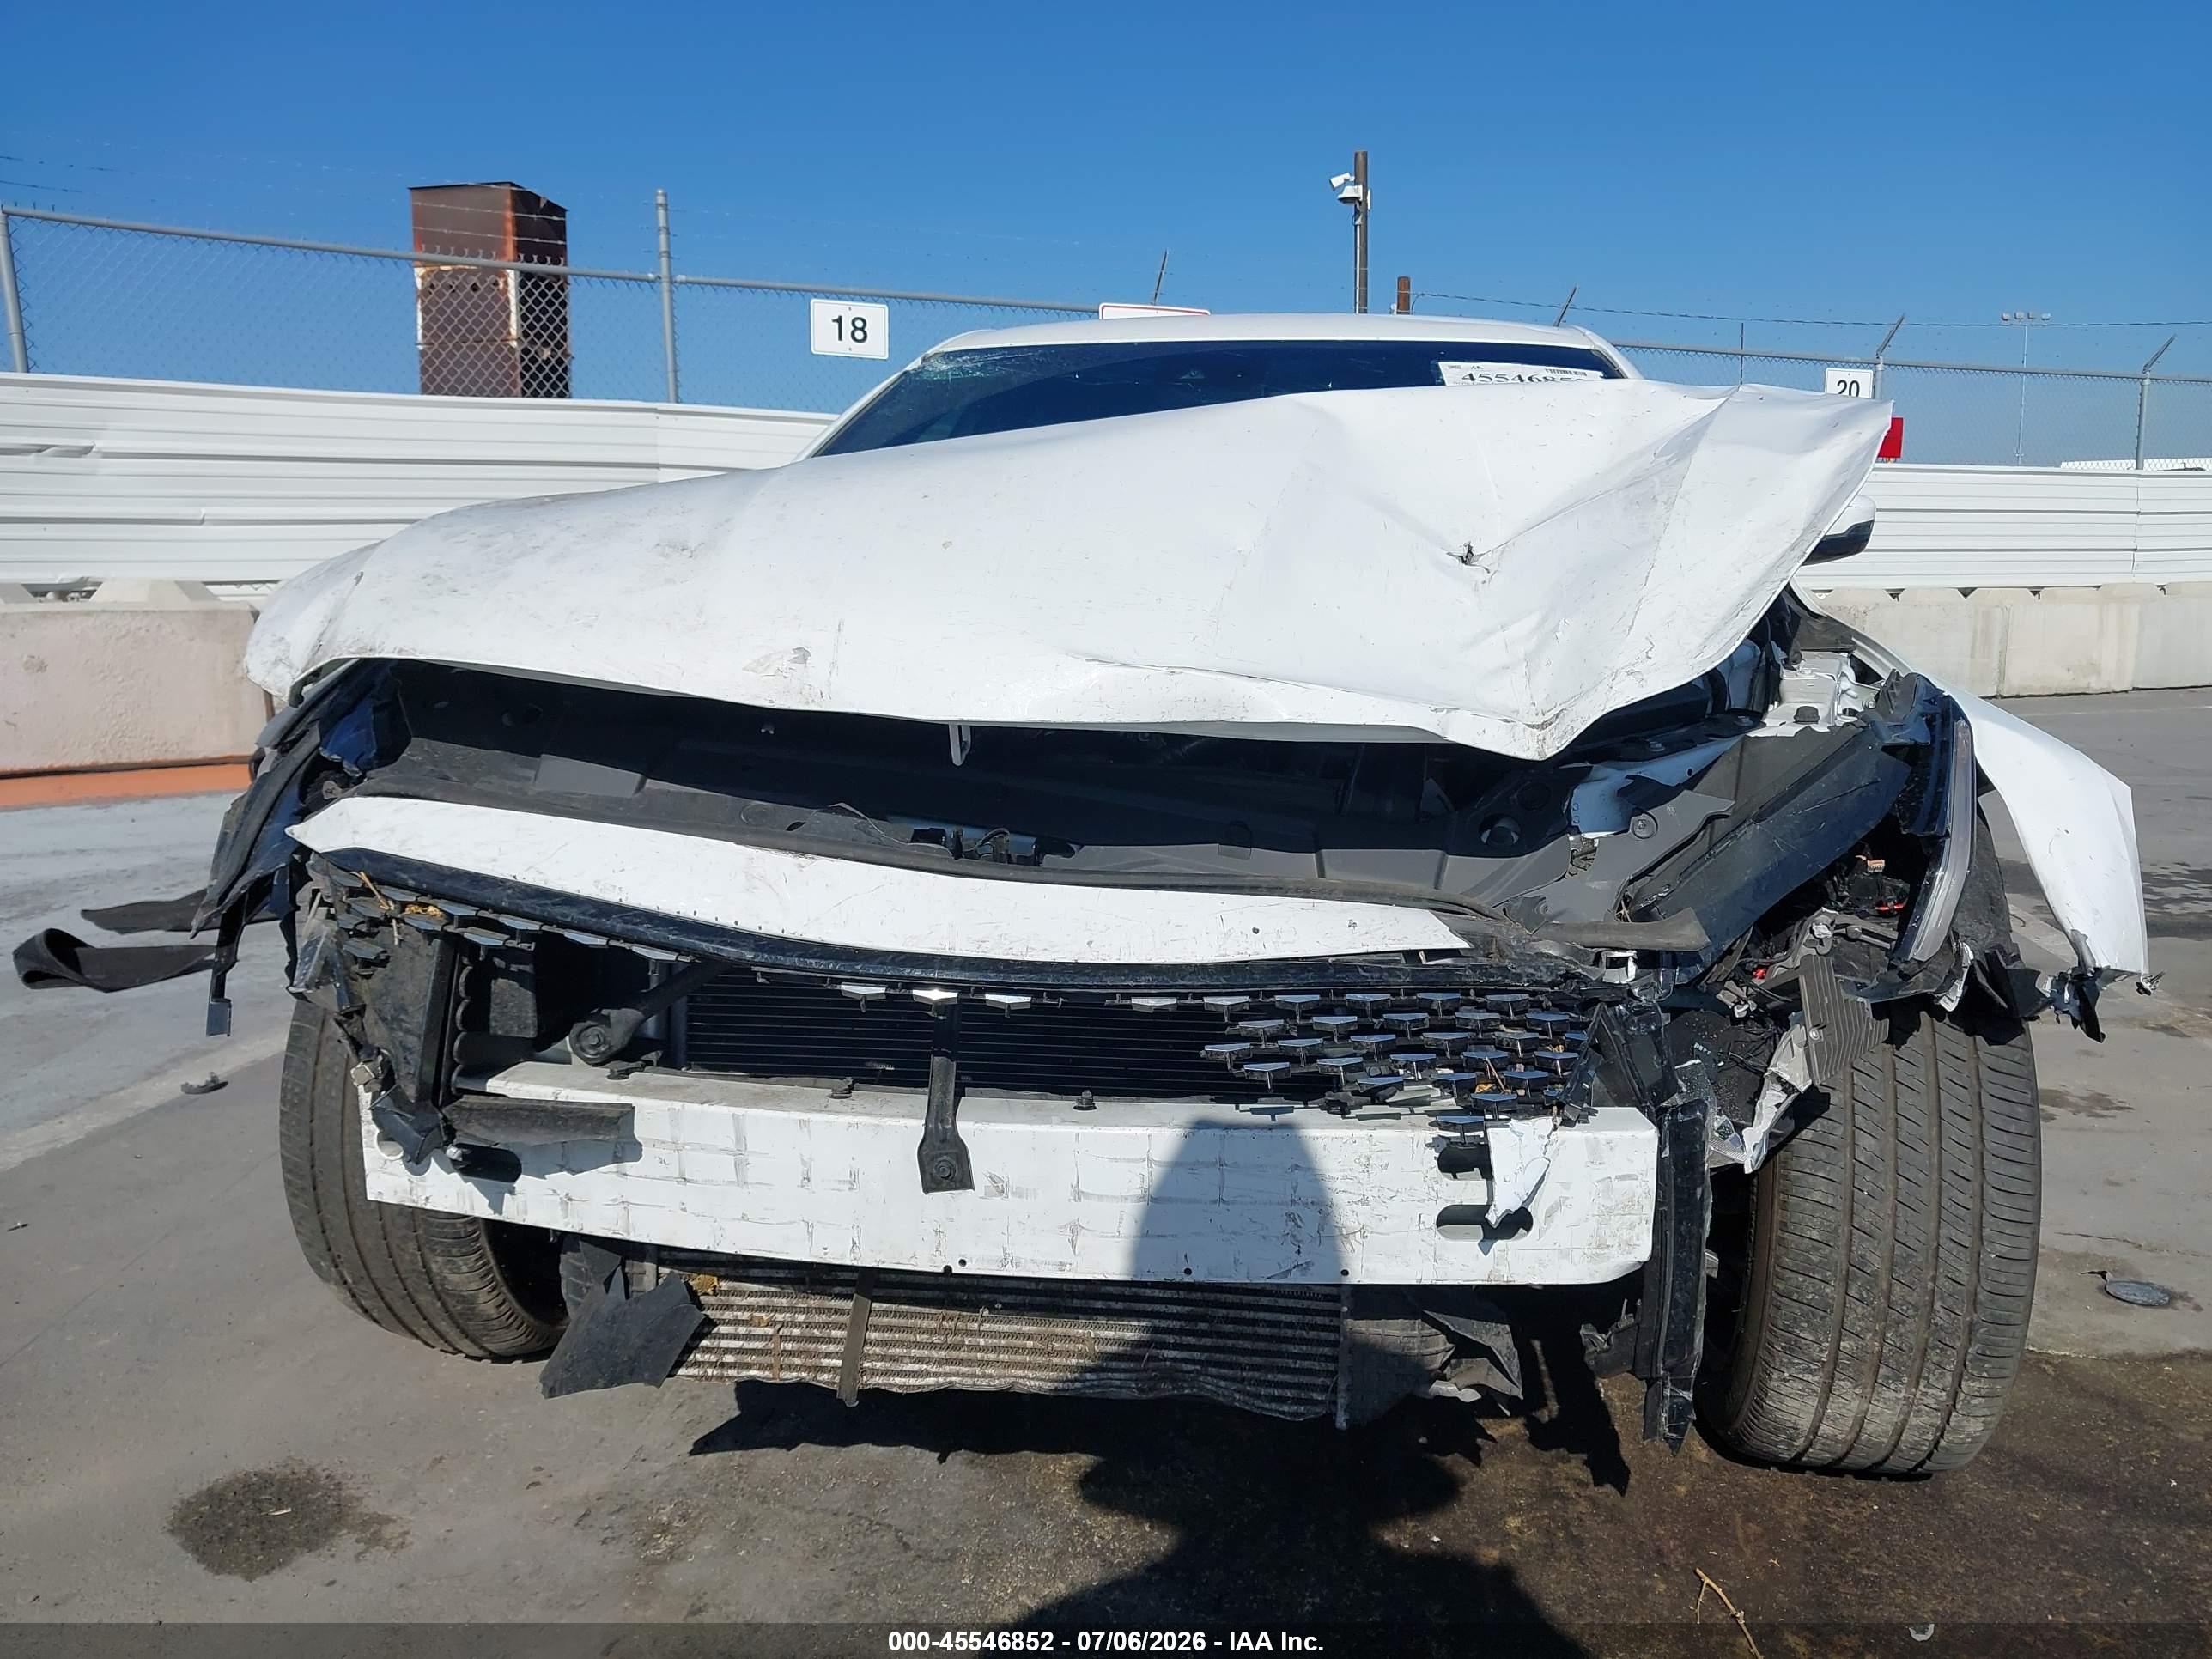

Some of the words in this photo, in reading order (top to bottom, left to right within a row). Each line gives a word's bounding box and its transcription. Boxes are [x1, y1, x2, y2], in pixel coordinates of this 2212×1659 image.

[831, 315, 868, 343] 18
[1462, 373, 1586, 383] 455468
[1837, 380, 1860, 397] 20
